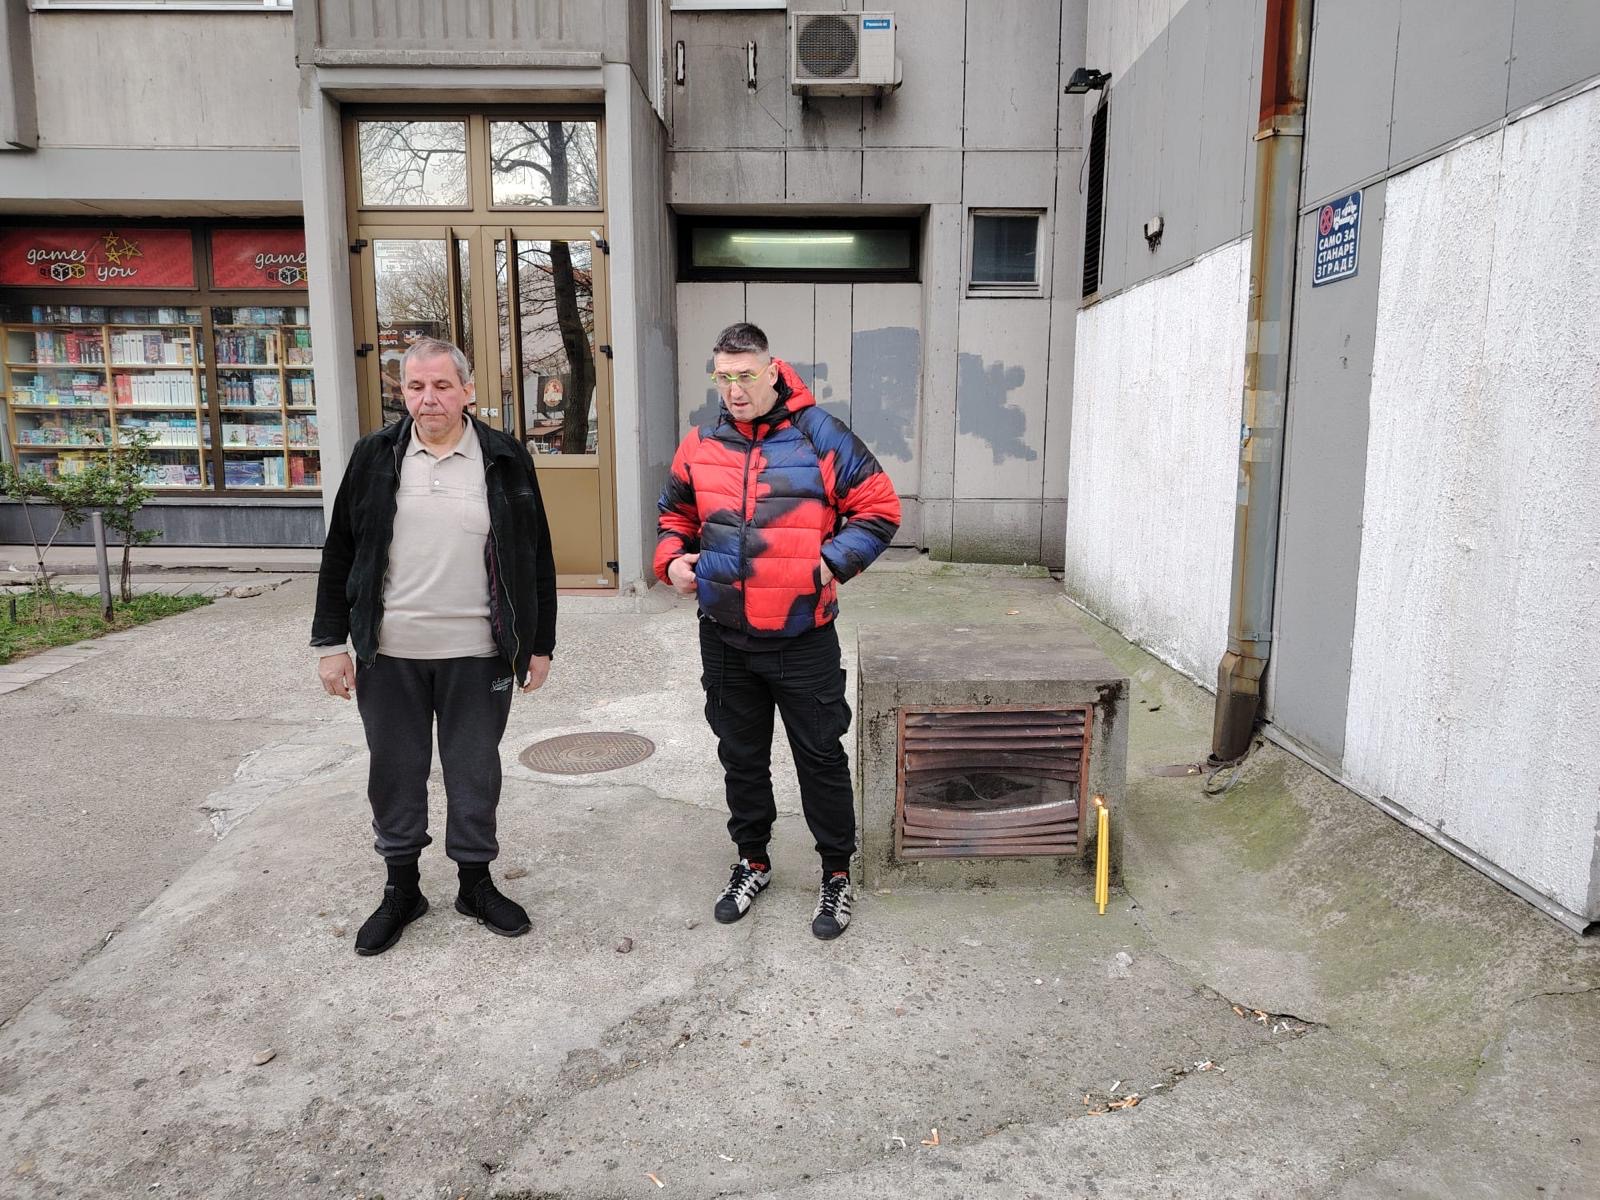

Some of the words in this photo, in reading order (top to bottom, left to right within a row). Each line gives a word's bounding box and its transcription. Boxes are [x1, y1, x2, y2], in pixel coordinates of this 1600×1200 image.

[1319, 233, 1342, 251] САМО
[1344, 228, 1355, 242] ЗА
[26, 249, 86, 265] games
[255, 252, 307, 269] game
[1318, 242, 1354, 263] СТАНАРЕ
[97, 267, 138, 281] you
[1317, 256, 1354, 277] ЗГРАДЕ
